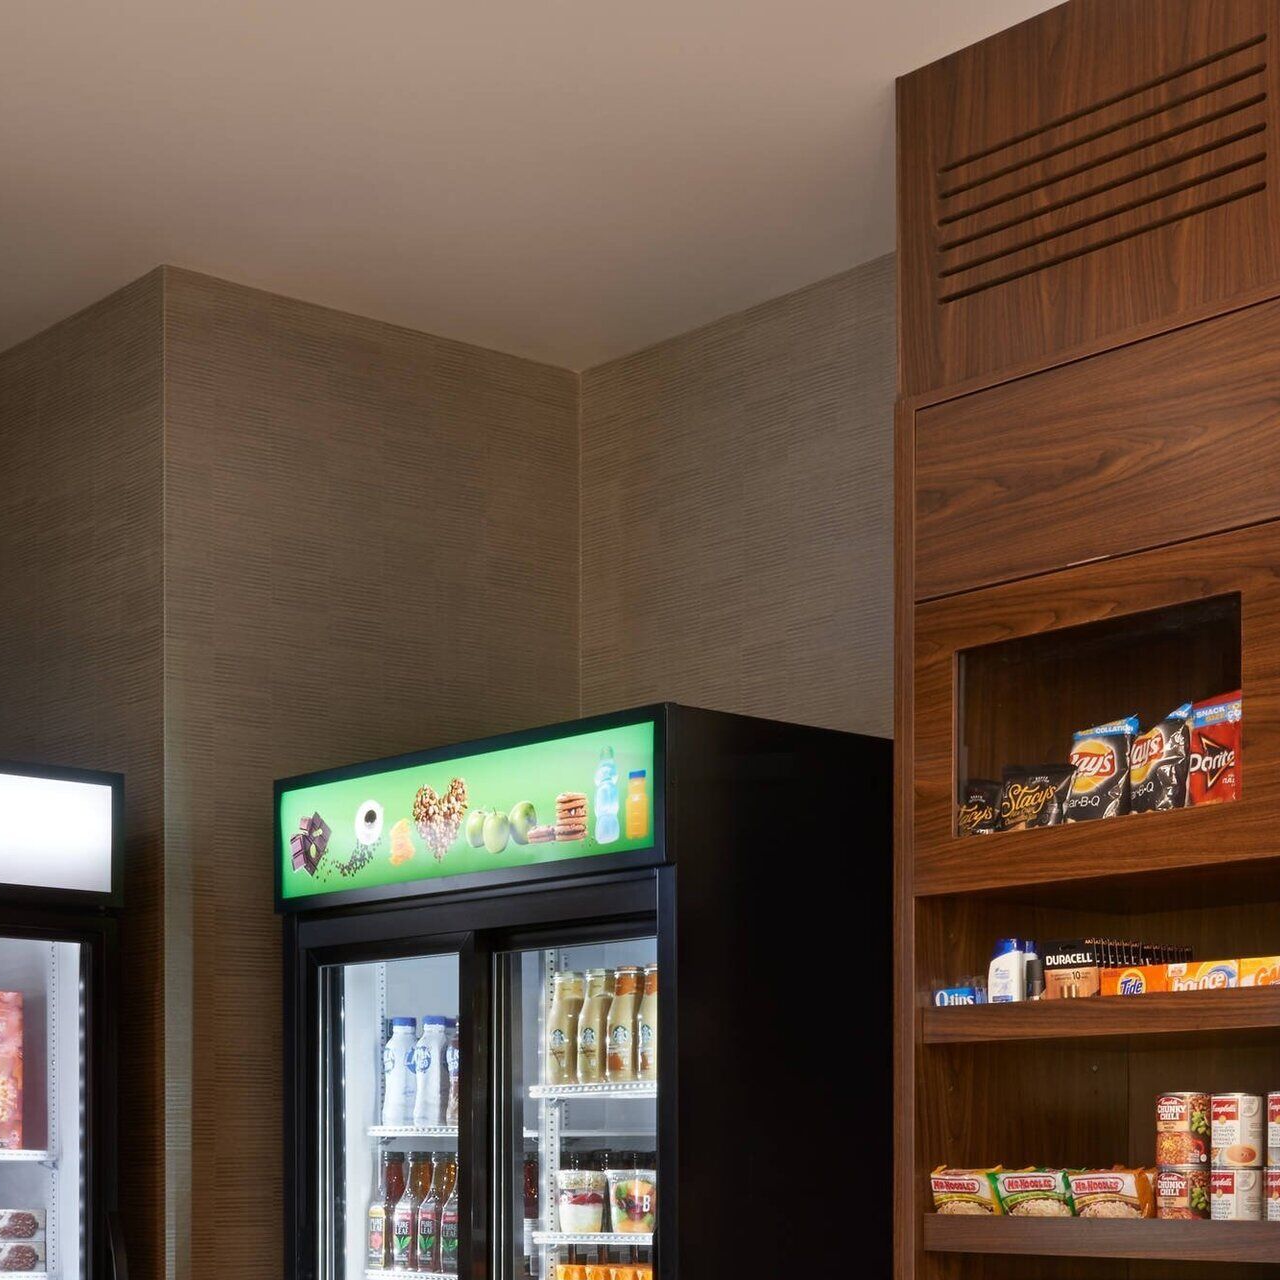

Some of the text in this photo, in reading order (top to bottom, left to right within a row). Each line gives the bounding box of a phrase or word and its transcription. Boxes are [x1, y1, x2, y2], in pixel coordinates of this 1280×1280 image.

[1045, 952, 1093, 966] DURACELL
[1120, 978, 1143, 995] Tide
[1157, 1104, 1187, 1114] CHUNKY
[1157, 1180, 1187, 1189] CHUNKY
